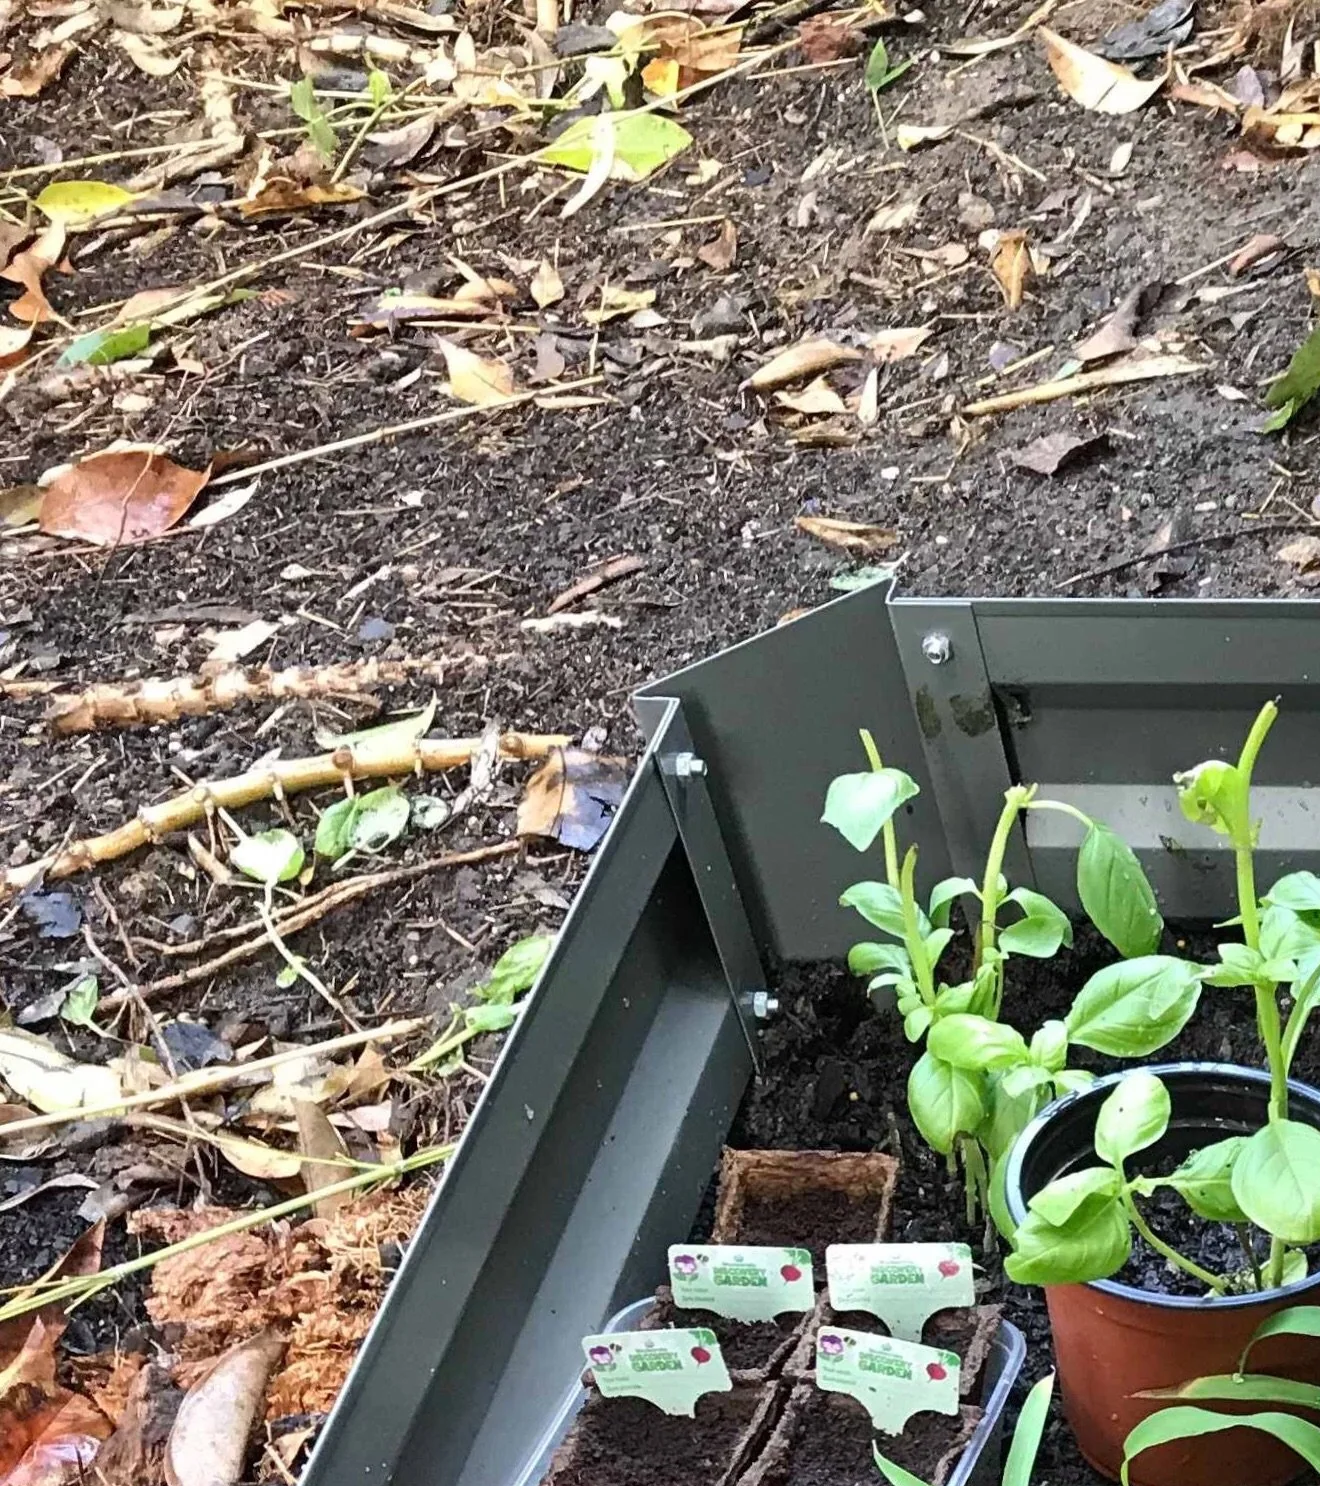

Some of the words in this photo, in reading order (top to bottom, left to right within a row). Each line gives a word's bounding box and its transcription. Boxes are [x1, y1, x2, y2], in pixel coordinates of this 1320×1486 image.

[714, 1275, 768, 1287] GARDEN
[871, 1273, 924, 1285] GARDEN
[859, 1360, 912, 1380] GARDEN
